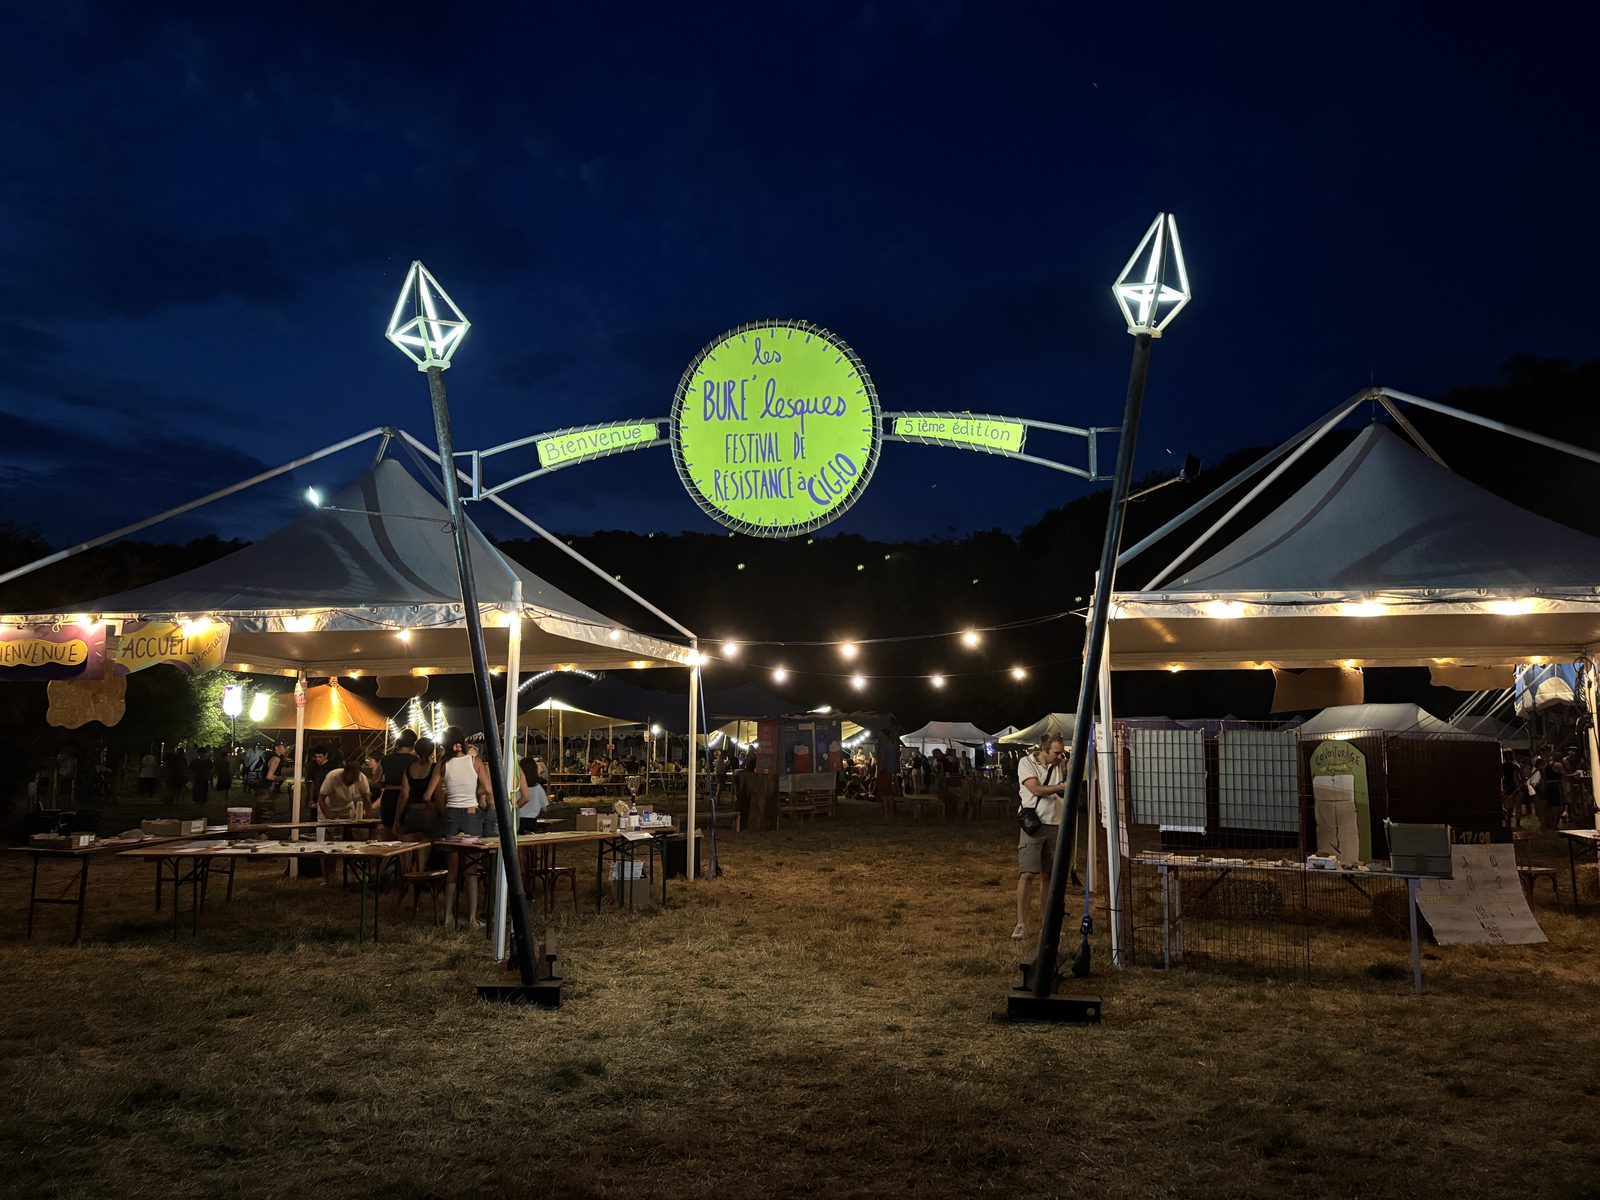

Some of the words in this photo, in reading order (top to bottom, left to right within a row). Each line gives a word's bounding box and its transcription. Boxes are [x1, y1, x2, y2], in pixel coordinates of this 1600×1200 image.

[752, 337, 782, 365] les
[544, 426, 642, 461] Bienvenue
[903, 420, 914, 434] 5
[917, 420, 946, 433] ième
[952, 421, 1011, 441] édition
[793, 431, 807, 461] DE
[797, 470, 807, 491] à
[0, 642, 79, 664] IENVENUE
[121, 634, 195, 660] ACCUEIL
